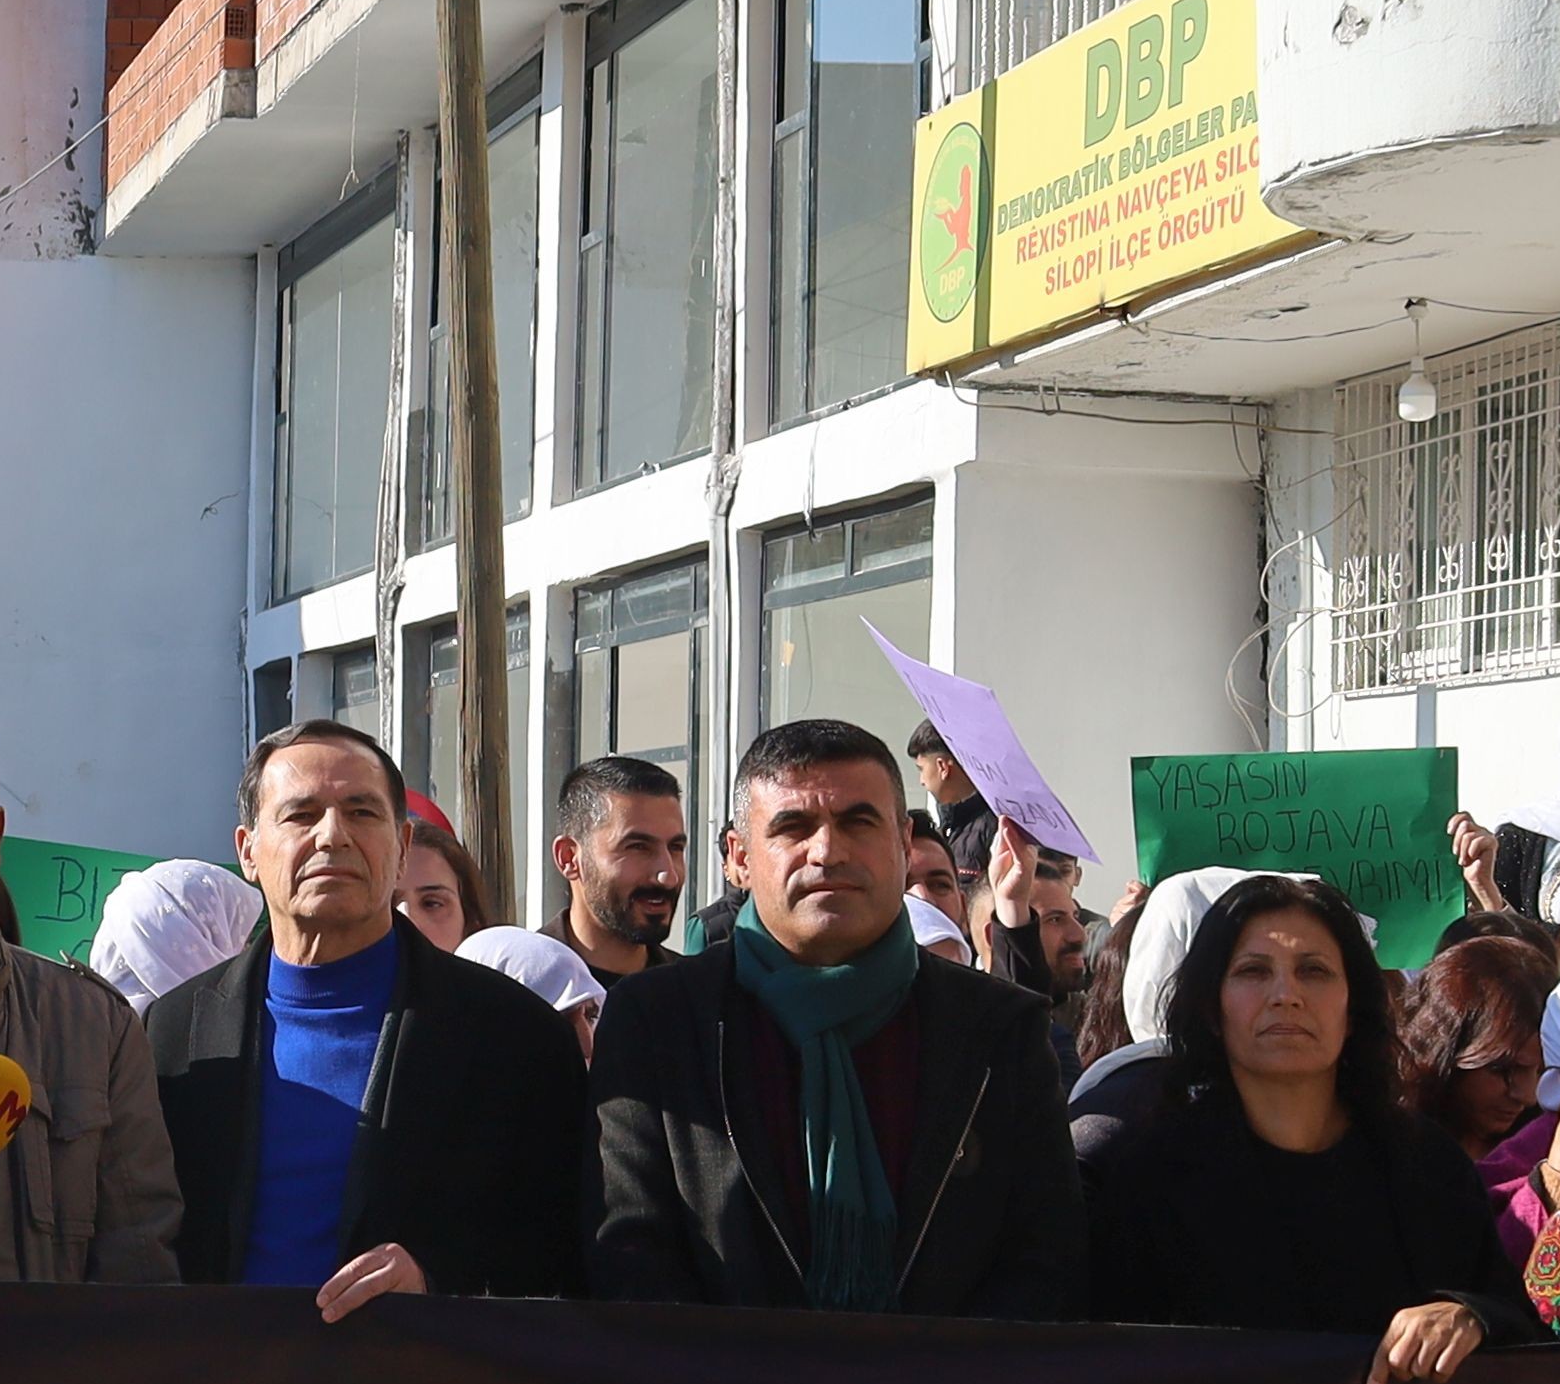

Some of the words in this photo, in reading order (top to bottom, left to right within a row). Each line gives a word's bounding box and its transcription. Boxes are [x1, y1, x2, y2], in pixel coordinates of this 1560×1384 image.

[997, 153, 1115, 236] DEMOKRATİK
[1118, 105, 1225, 182] BÖLGELER
[1016, 199, 1110, 265] RÊXISTINA
[1117, 158, 1208, 222] NAVÇEYA
[1045, 238, 1103, 296] SİLOPİ
[1109, 226, 1152, 271] İLÇE
[1158, 186, 1246, 251] ÖRGÜTÜ
[939, 266, 965, 297] DBP
[1148, 759, 1308, 811] YAŞASIN
[1216, 804, 1394, 855] ROJAVA
